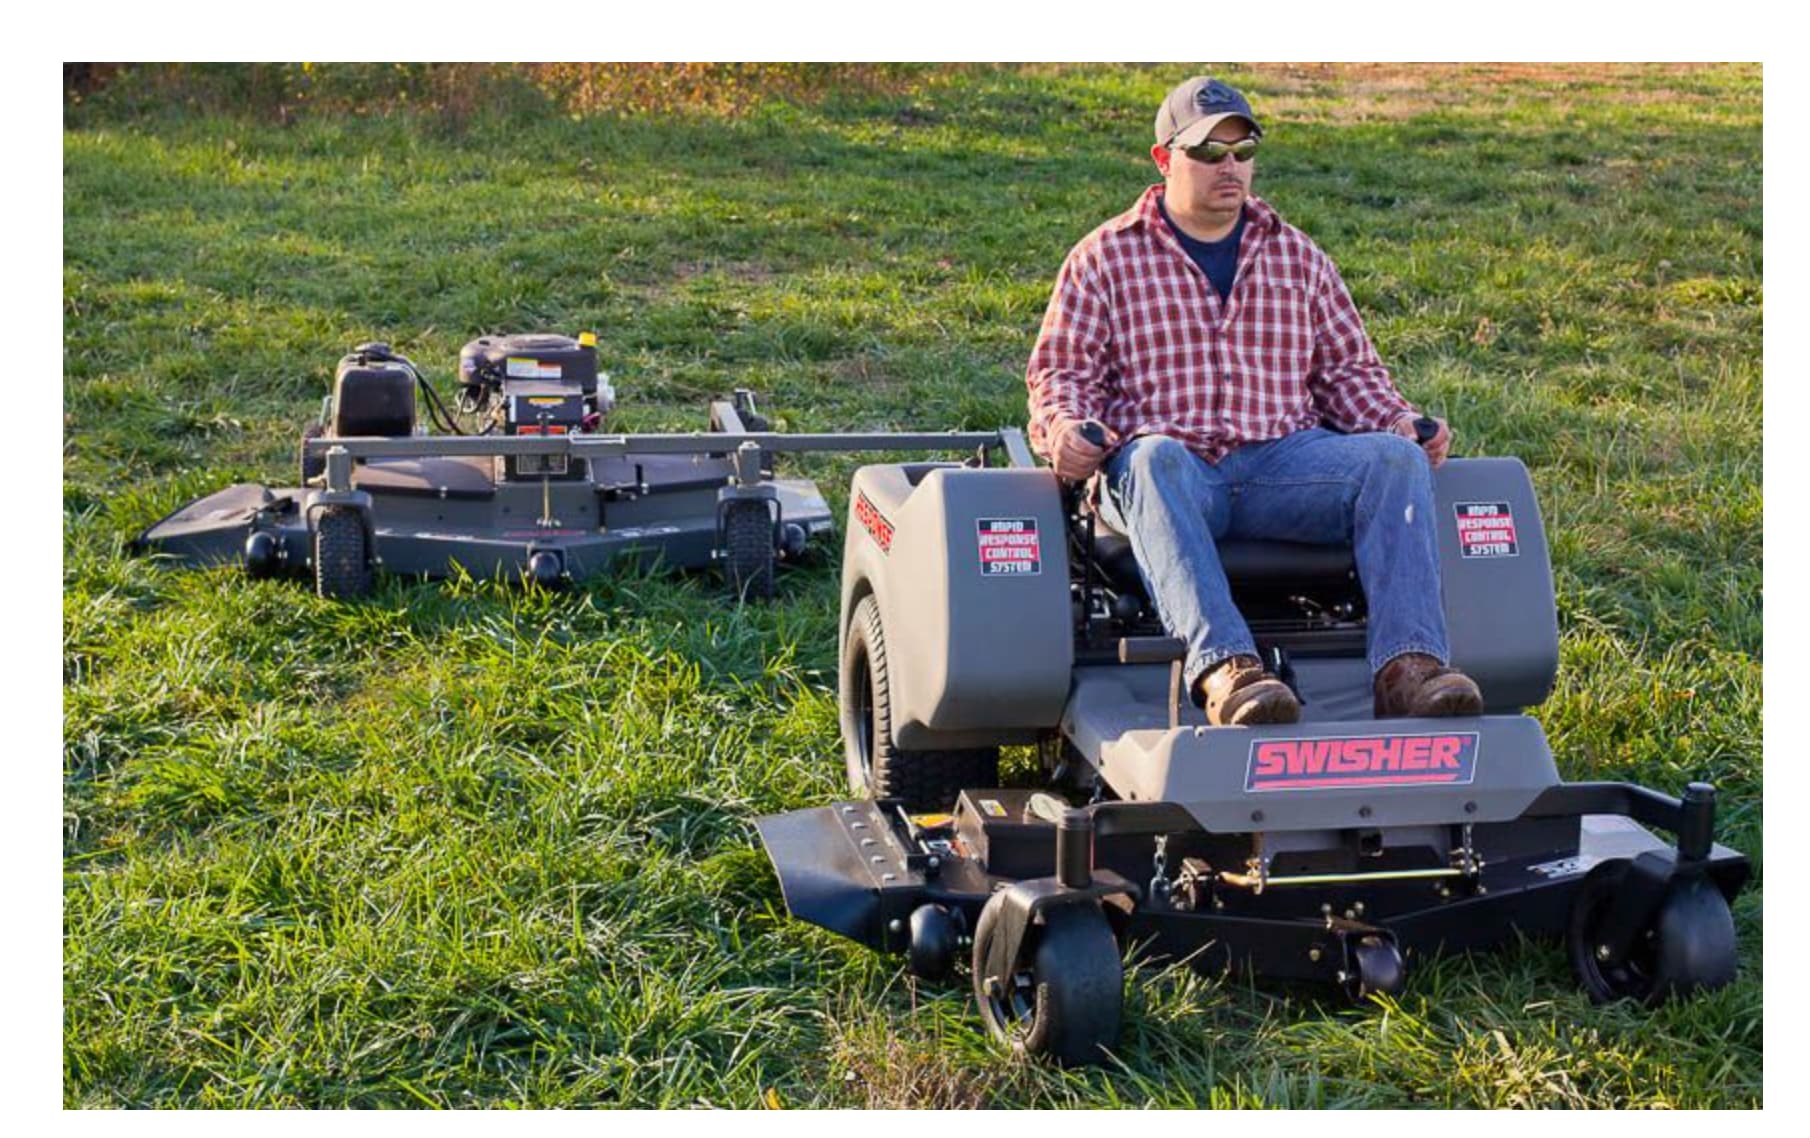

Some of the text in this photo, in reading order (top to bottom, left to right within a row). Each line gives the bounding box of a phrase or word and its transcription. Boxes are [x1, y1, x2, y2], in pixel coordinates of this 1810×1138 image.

[1457, 518, 1514, 530] RESPONSE
[979, 534, 1039, 547] RESPONSE
[1464, 531, 1512, 543] CONTROL
[985, 547, 1035, 560] CONTROL
[1470, 543, 1510, 556] SYSTEM
[990, 561, 1032, 573] SYSTEM
[1255, 736, 1462, 775] SWISHER
